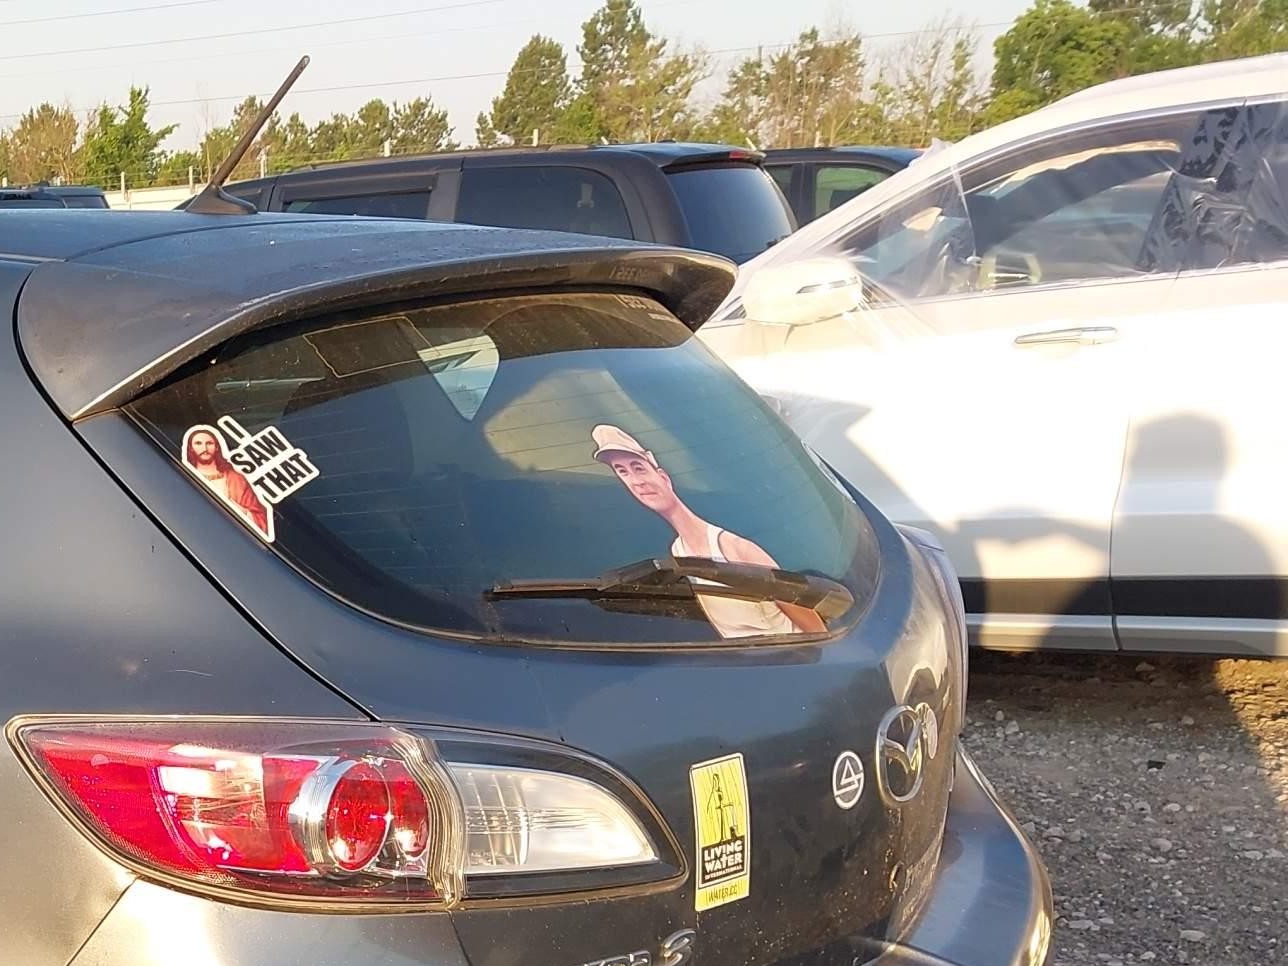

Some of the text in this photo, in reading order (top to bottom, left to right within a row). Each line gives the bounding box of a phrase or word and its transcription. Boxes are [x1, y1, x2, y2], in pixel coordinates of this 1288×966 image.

[223, 420, 245, 439] I
[230, 430, 288, 474] SAW
[252, 453, 314, 499] THAT
[704, 840, 743, 861] LIVING
[705, 853, 743, 873] WATER
